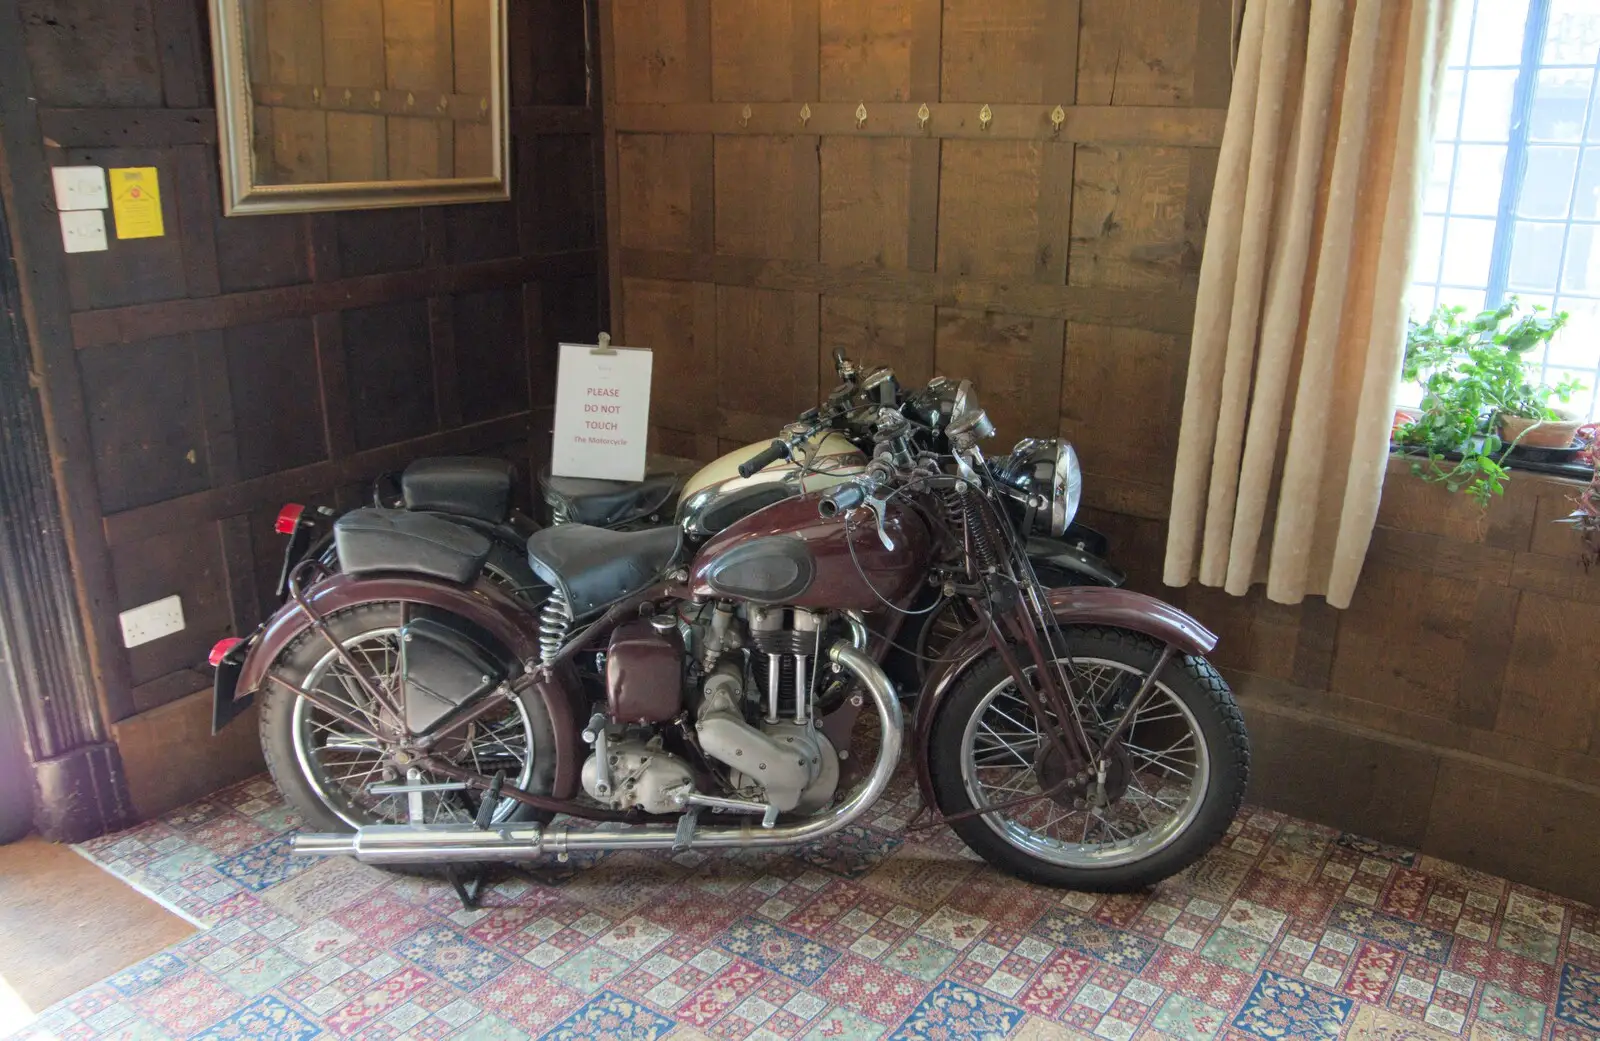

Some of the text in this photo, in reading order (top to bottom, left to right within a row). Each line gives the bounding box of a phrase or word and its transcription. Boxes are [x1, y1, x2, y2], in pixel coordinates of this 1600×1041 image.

[587, 387, 620, 397] PLEASE
[584, 404, 621, 414] DO NOT
[585, 421, 618, 430] TOUCH
[588, 437, 628, 446] Motorcycle
